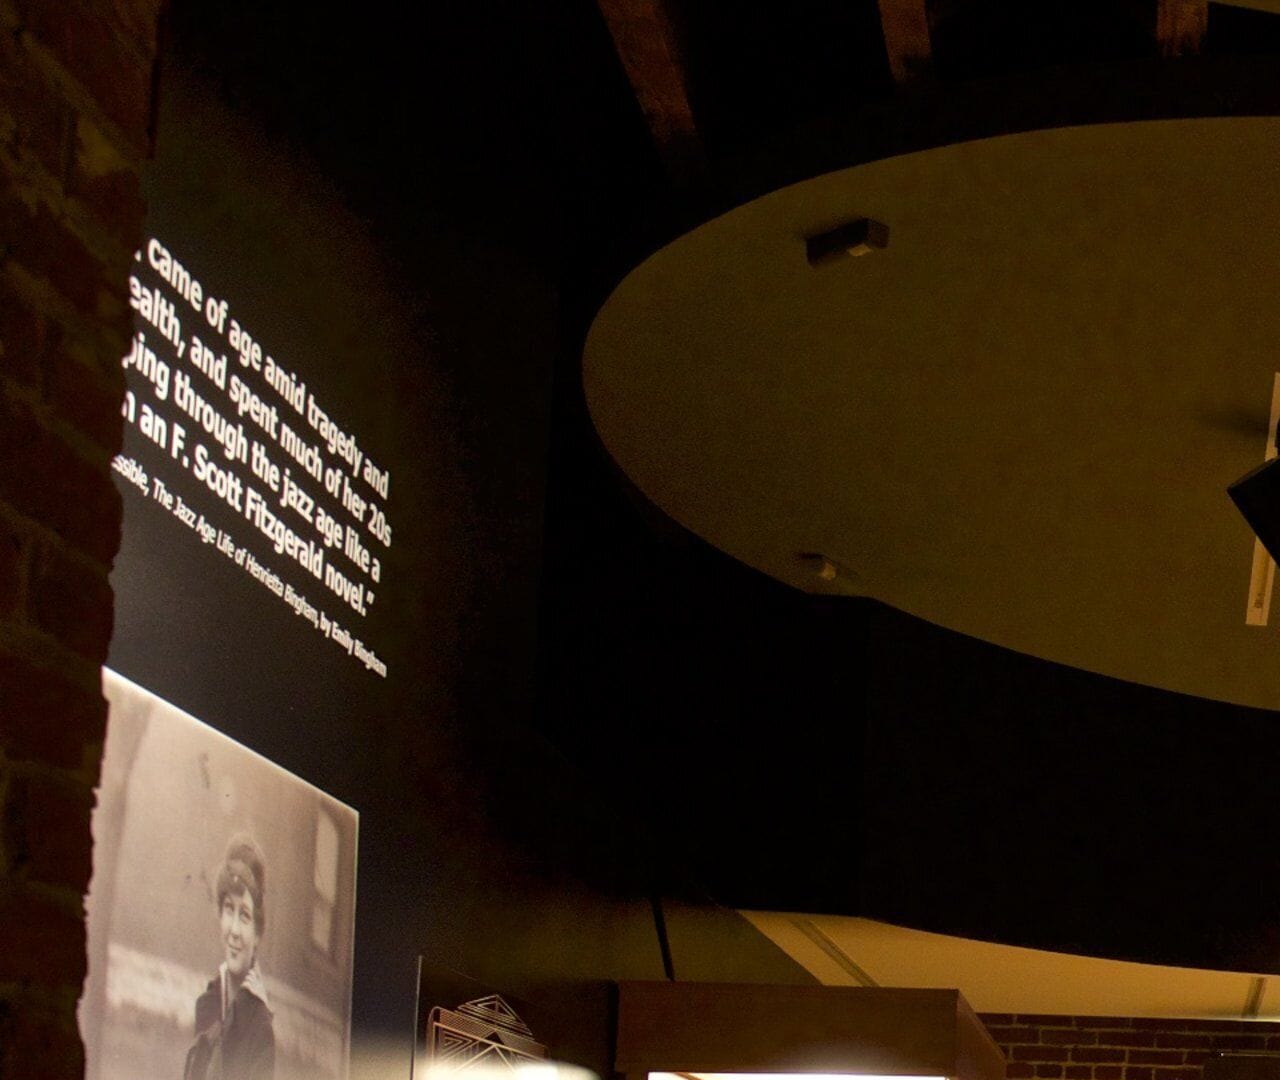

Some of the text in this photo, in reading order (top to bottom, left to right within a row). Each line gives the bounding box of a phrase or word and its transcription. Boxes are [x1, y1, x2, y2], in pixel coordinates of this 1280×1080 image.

[148, 238, 389, 500] came of age amid tragedy and
[190, 335, 228, 391] and
[229, 374, 279, 441] spent
[280, 422, 323, 482] much
[325, 467, 343, 498] of
[342, 476, 367, 522] her
[368, 503, 392, 547] 20s
[140, 403, 167, 449] an
[171, 423, 189, 468] F.
[193, 444, 243, 513] Scott
[245, 486, 323, 580] Fitzgerald
[152, 477, 173, 511] The
[172, 496, 197, 529] Jazz
[196, 515, 216, 544] Age
[216, 529, 235, 559] Life
[234, 547, 247, 566] of
[245, 553, 285, 598] Henrietta
[319, 611, 332, 639] by
[174, 370, 248, 464] through
[251, 440, 280, 492] the
[280, 467, 314, 523] jazz
[315, 507, 343, 549] age
[344, 525, 371, 573] like
[371, 558, 380, 583] a
